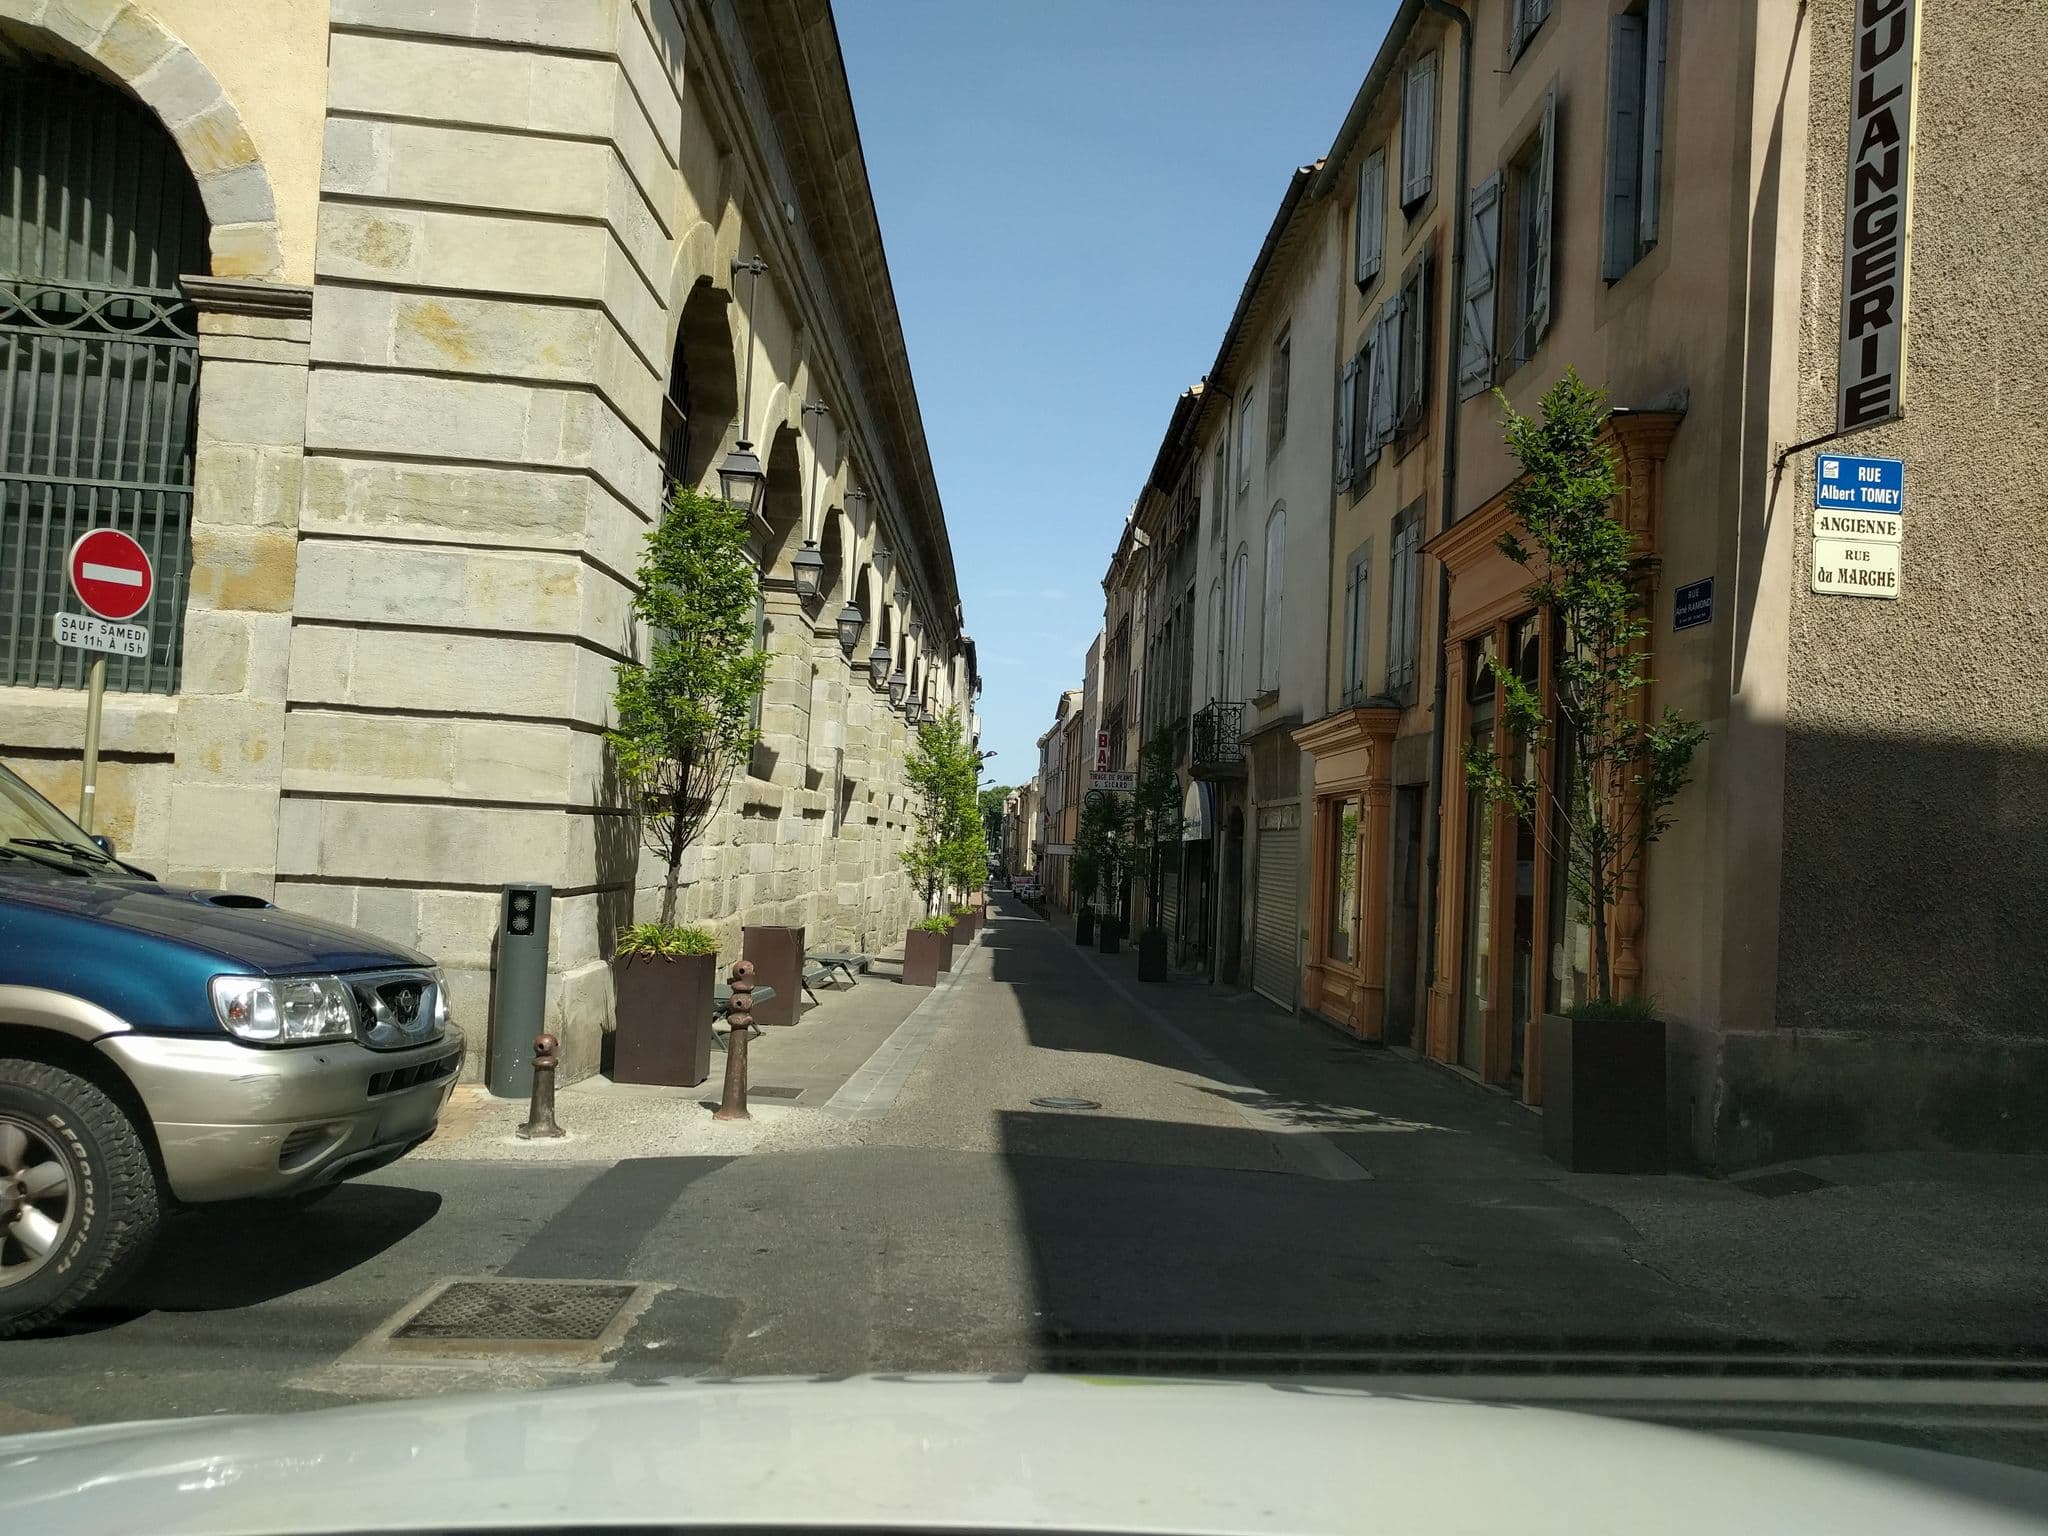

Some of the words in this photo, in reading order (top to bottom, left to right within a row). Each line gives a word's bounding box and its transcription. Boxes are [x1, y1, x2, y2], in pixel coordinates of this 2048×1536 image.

[1858, 466, 1882, 483] RUE
[1821, 485, 1856, 501] Albert
[1860, 487, 1899, 505] TOMEY
[1820, 516, 1897, 536] ANCIENNE
[1844, 550, 1871, 562] RUE
[1818, 566, 1833, 584] du
[1837, 567, 1896, 588] MARCHÉ
[1688, 588, 1699, 599] RUE
[61, 617, 94, 632] SAUF
[100, 624, 146, 641] SAMEDI
[61, 631, 78, 643] DE
[83, 634, 103, 648] 11h
[124, 642, 143, 654] 15h
